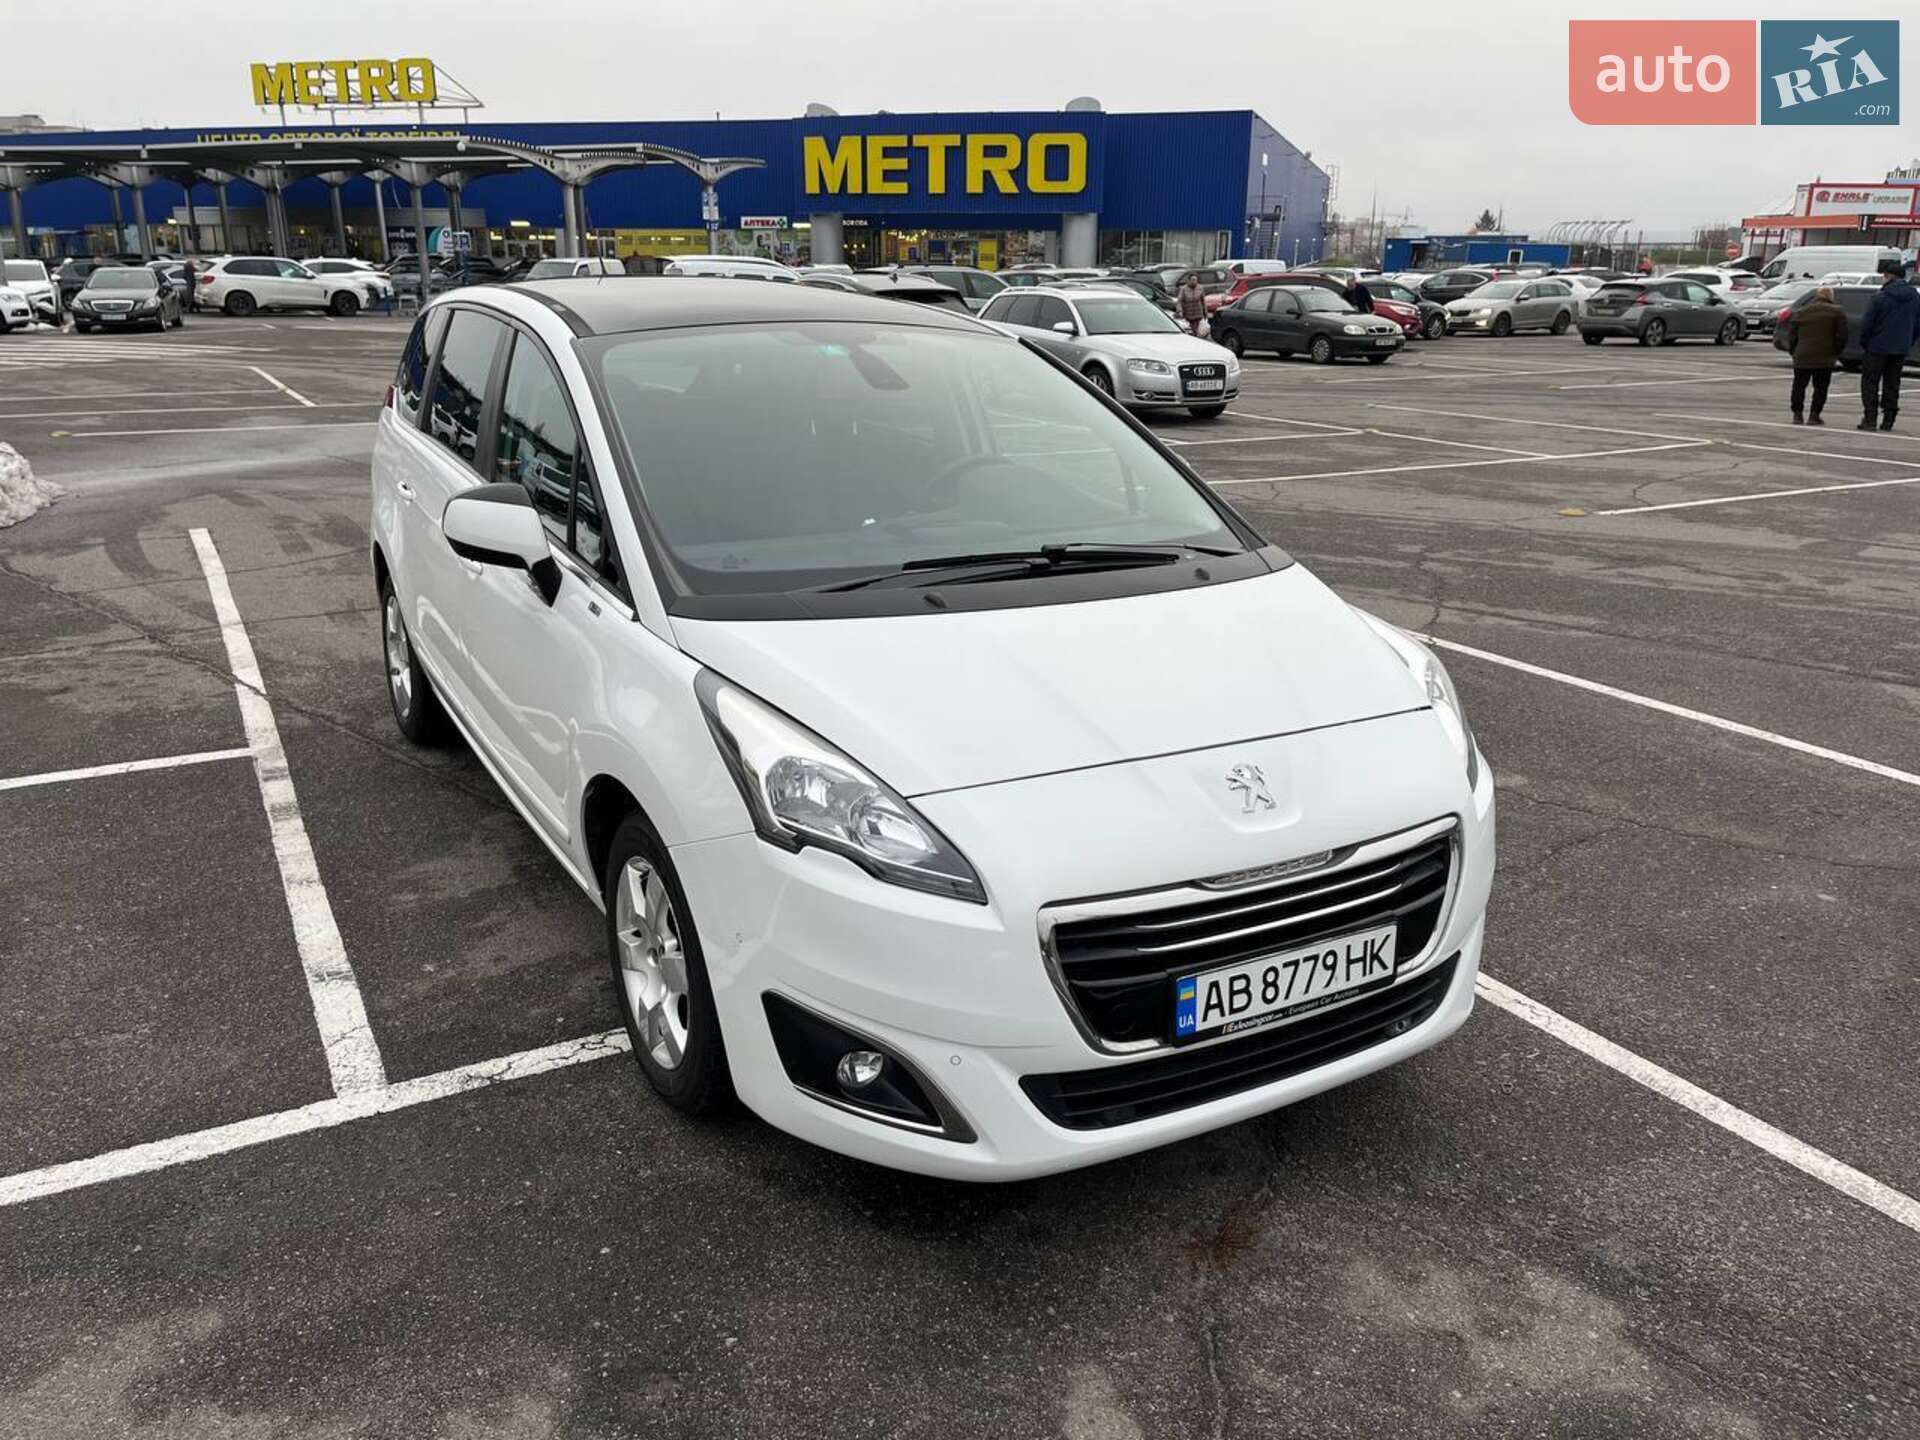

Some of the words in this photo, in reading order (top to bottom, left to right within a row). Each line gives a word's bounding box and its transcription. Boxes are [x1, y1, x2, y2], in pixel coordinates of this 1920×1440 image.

[250, 58, 436, 106] METRO
[803, 132, 1088, 195] METRO
[1201, 972, 1253, 1023] AB
[1260, 949, 1338, 1006] 8779
[1344, 934, 1392, 983] HK
[1178, 1015, 1195, 1029] UA
